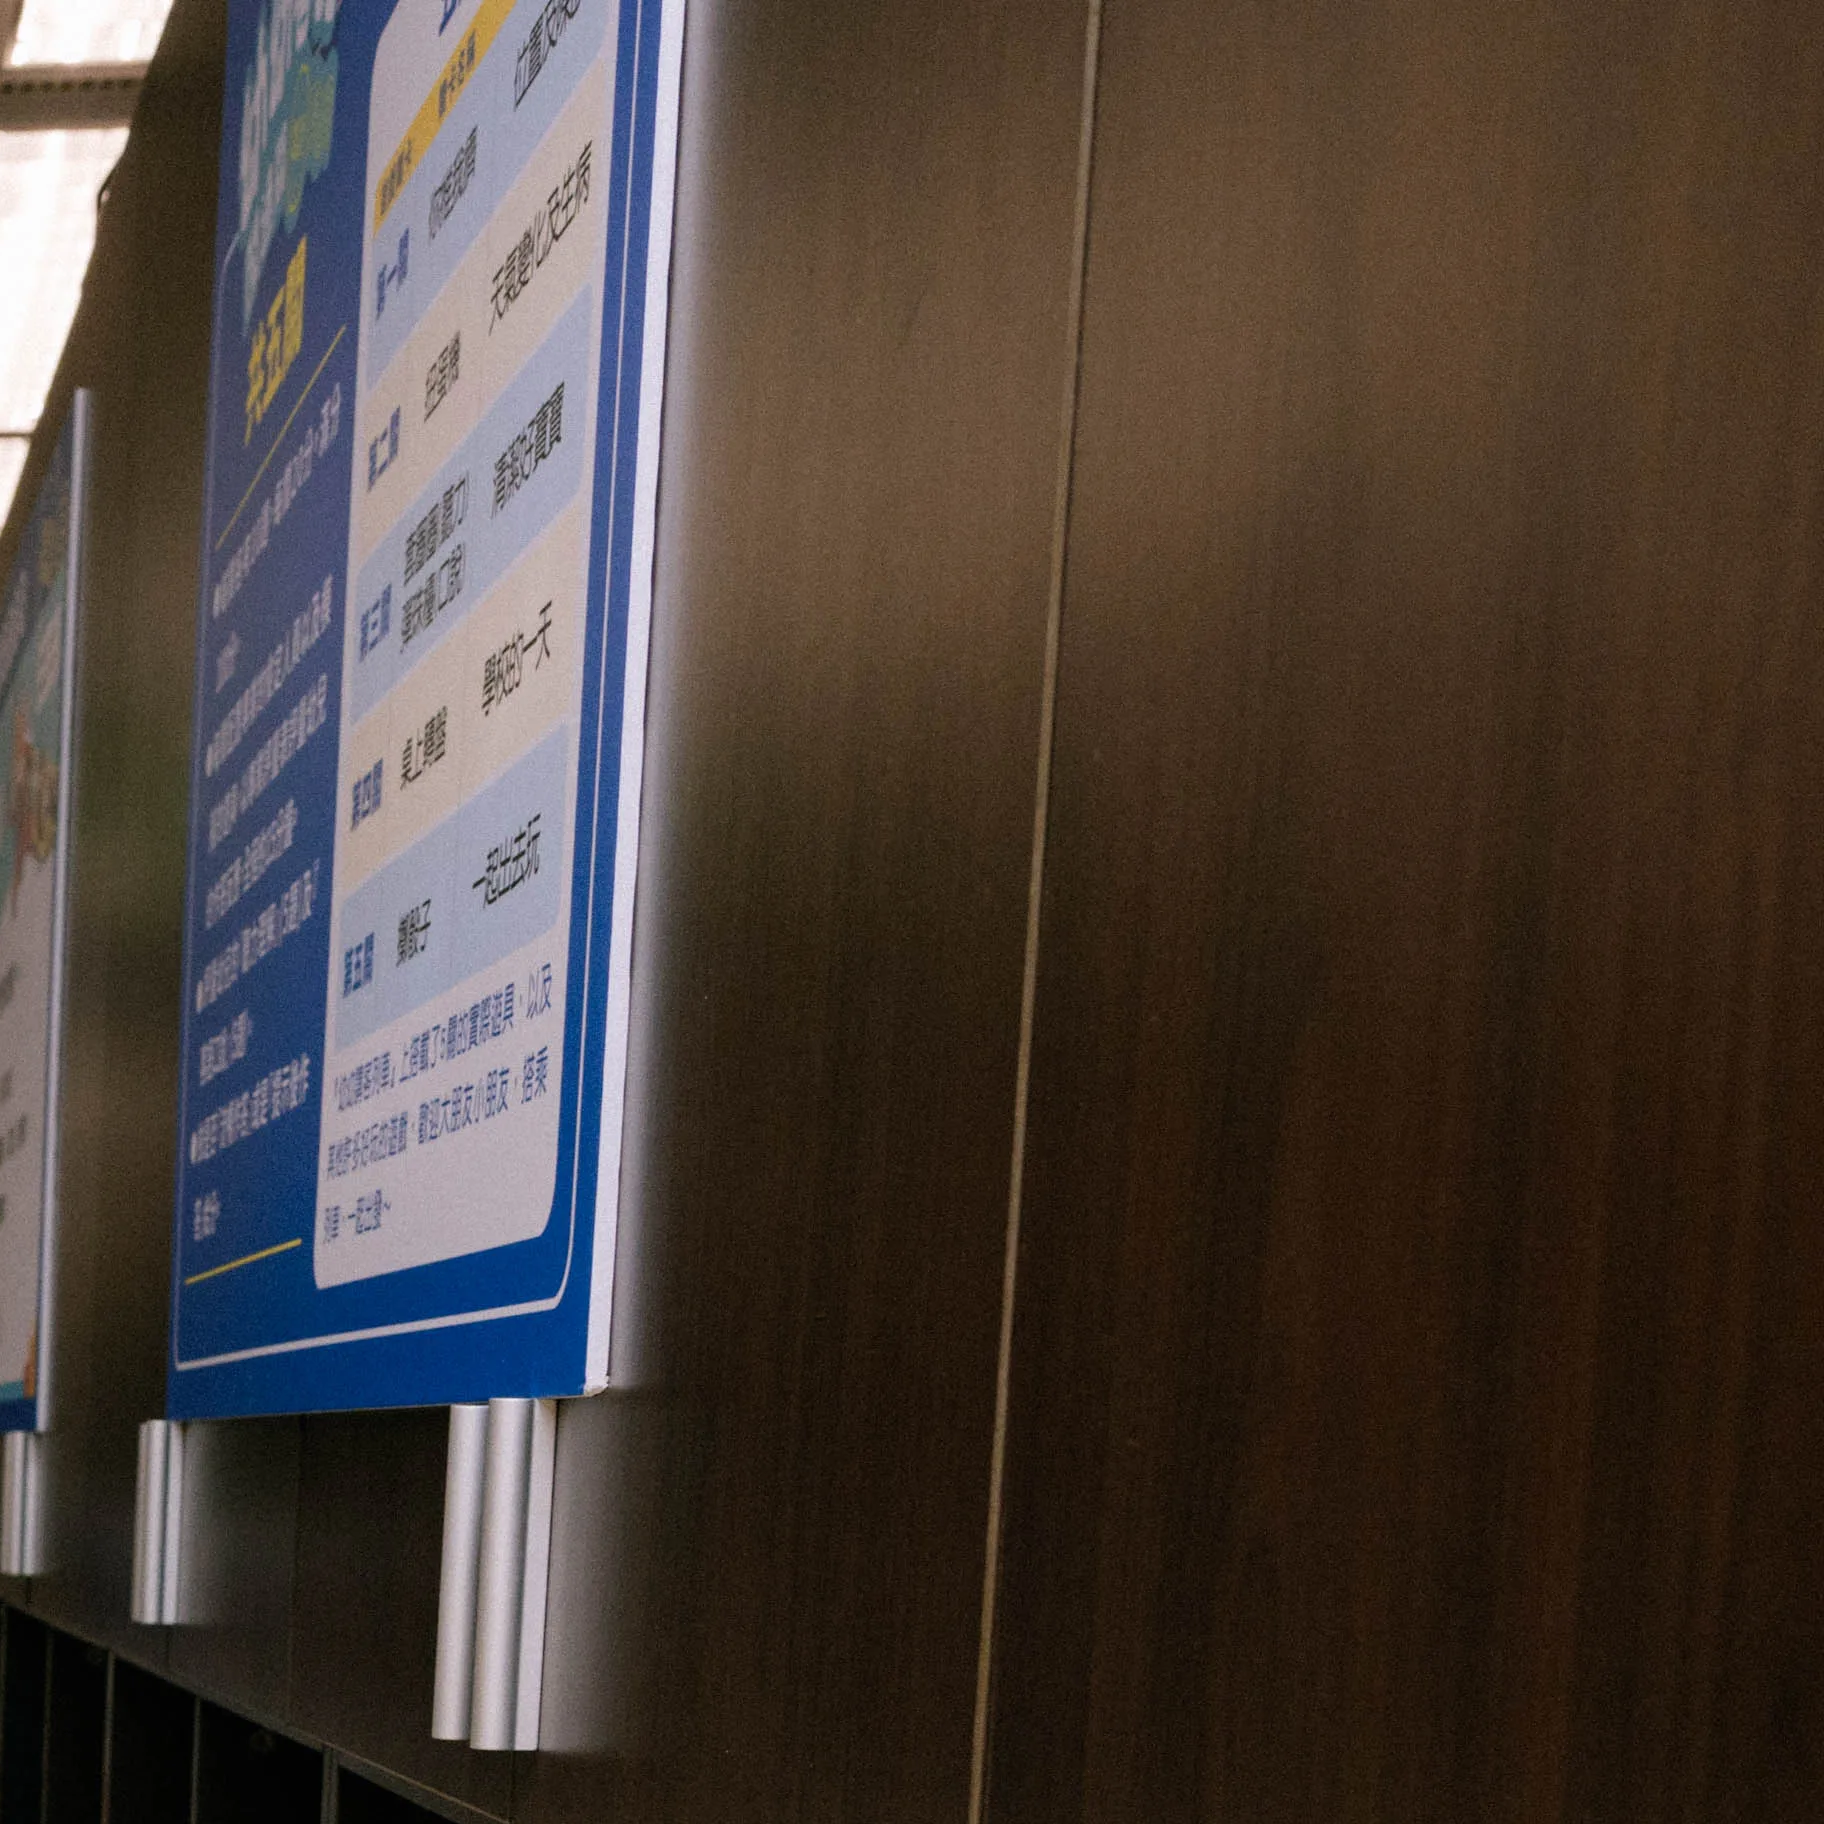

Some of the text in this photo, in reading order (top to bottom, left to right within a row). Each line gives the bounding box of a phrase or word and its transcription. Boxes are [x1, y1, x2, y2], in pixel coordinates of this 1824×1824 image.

[487, 139, 594, 336] 天氣變化及生病
[424, 329, 462, 423] 扭蛋機
[491, 380, 565, 518] 清潔好寶寶
[481, 600, 554, 716] 學校的一天
[343, 932, 376, 998] 第五關
[471, 814, 542, 909] 一起出去玩
